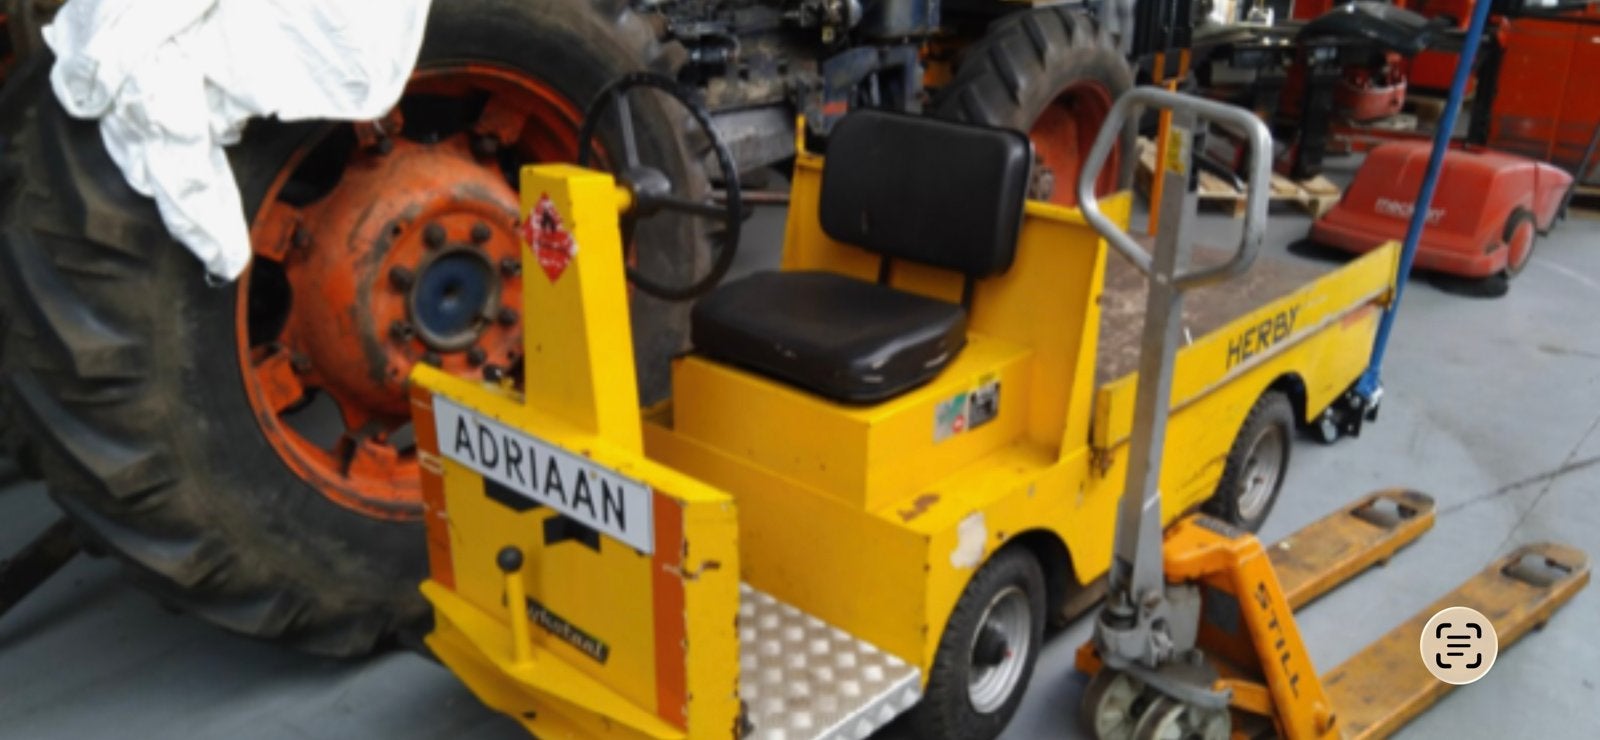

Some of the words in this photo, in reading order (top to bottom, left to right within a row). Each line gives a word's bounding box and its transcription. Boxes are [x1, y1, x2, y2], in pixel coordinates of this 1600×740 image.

[1226, 304, 1300, 371] HERBY
[454, 414, 627, 533] ADRIAAN
[1255, 581, 1300, 700] STILL
